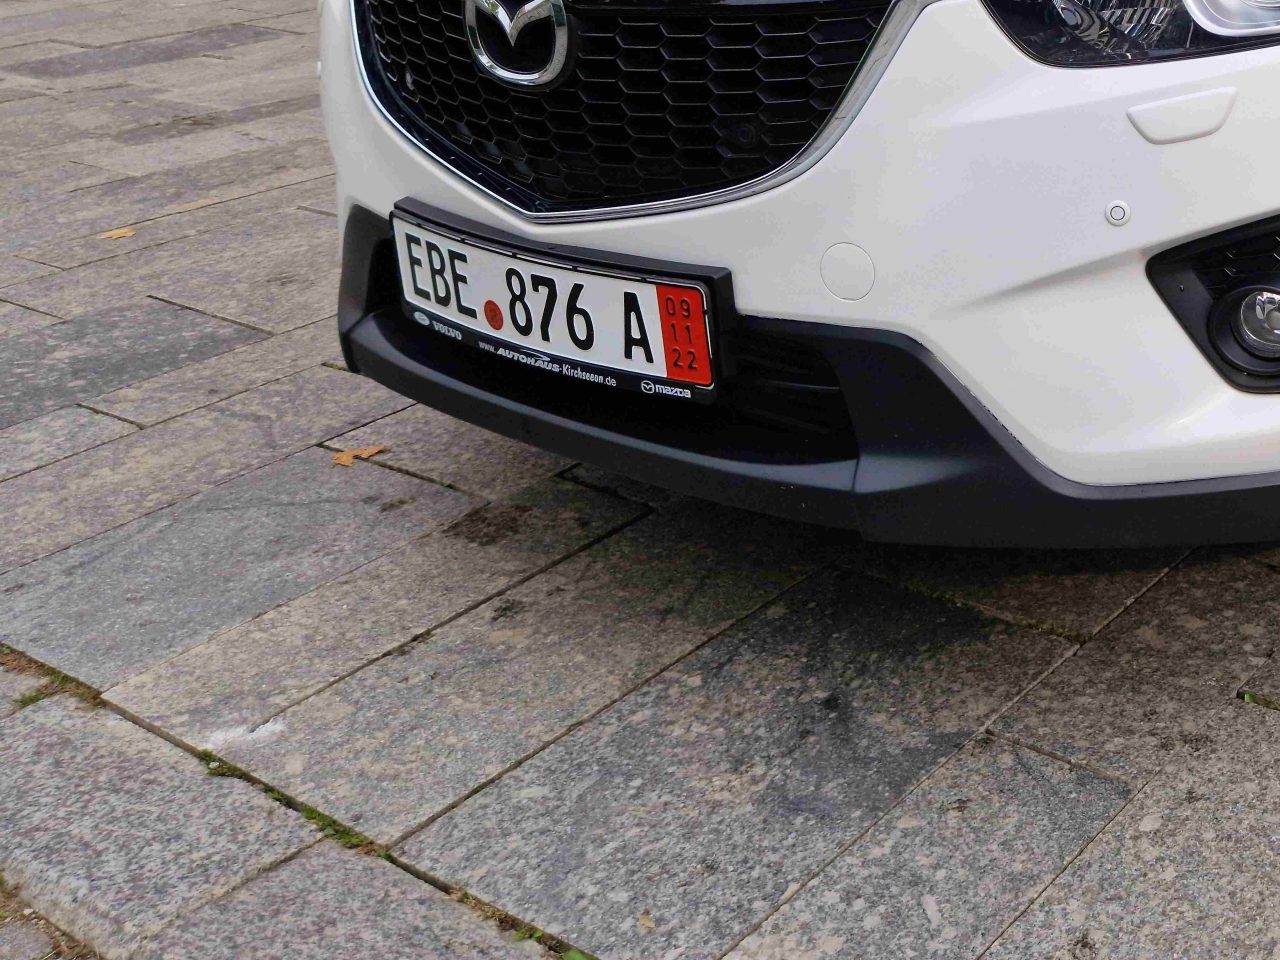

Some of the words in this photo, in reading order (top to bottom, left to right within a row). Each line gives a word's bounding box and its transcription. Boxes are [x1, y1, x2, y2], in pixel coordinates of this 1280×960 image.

[405, 232, 477, 319] EBE
[505, 268, 595, 351] 876
[624, 291, 654, 364] A
[665, 296, 690, 319] 09
[432, 320, 462, 340] VOLVO
[671, 323, 692, 344] 11
[672, 347, 698, 369] 22
